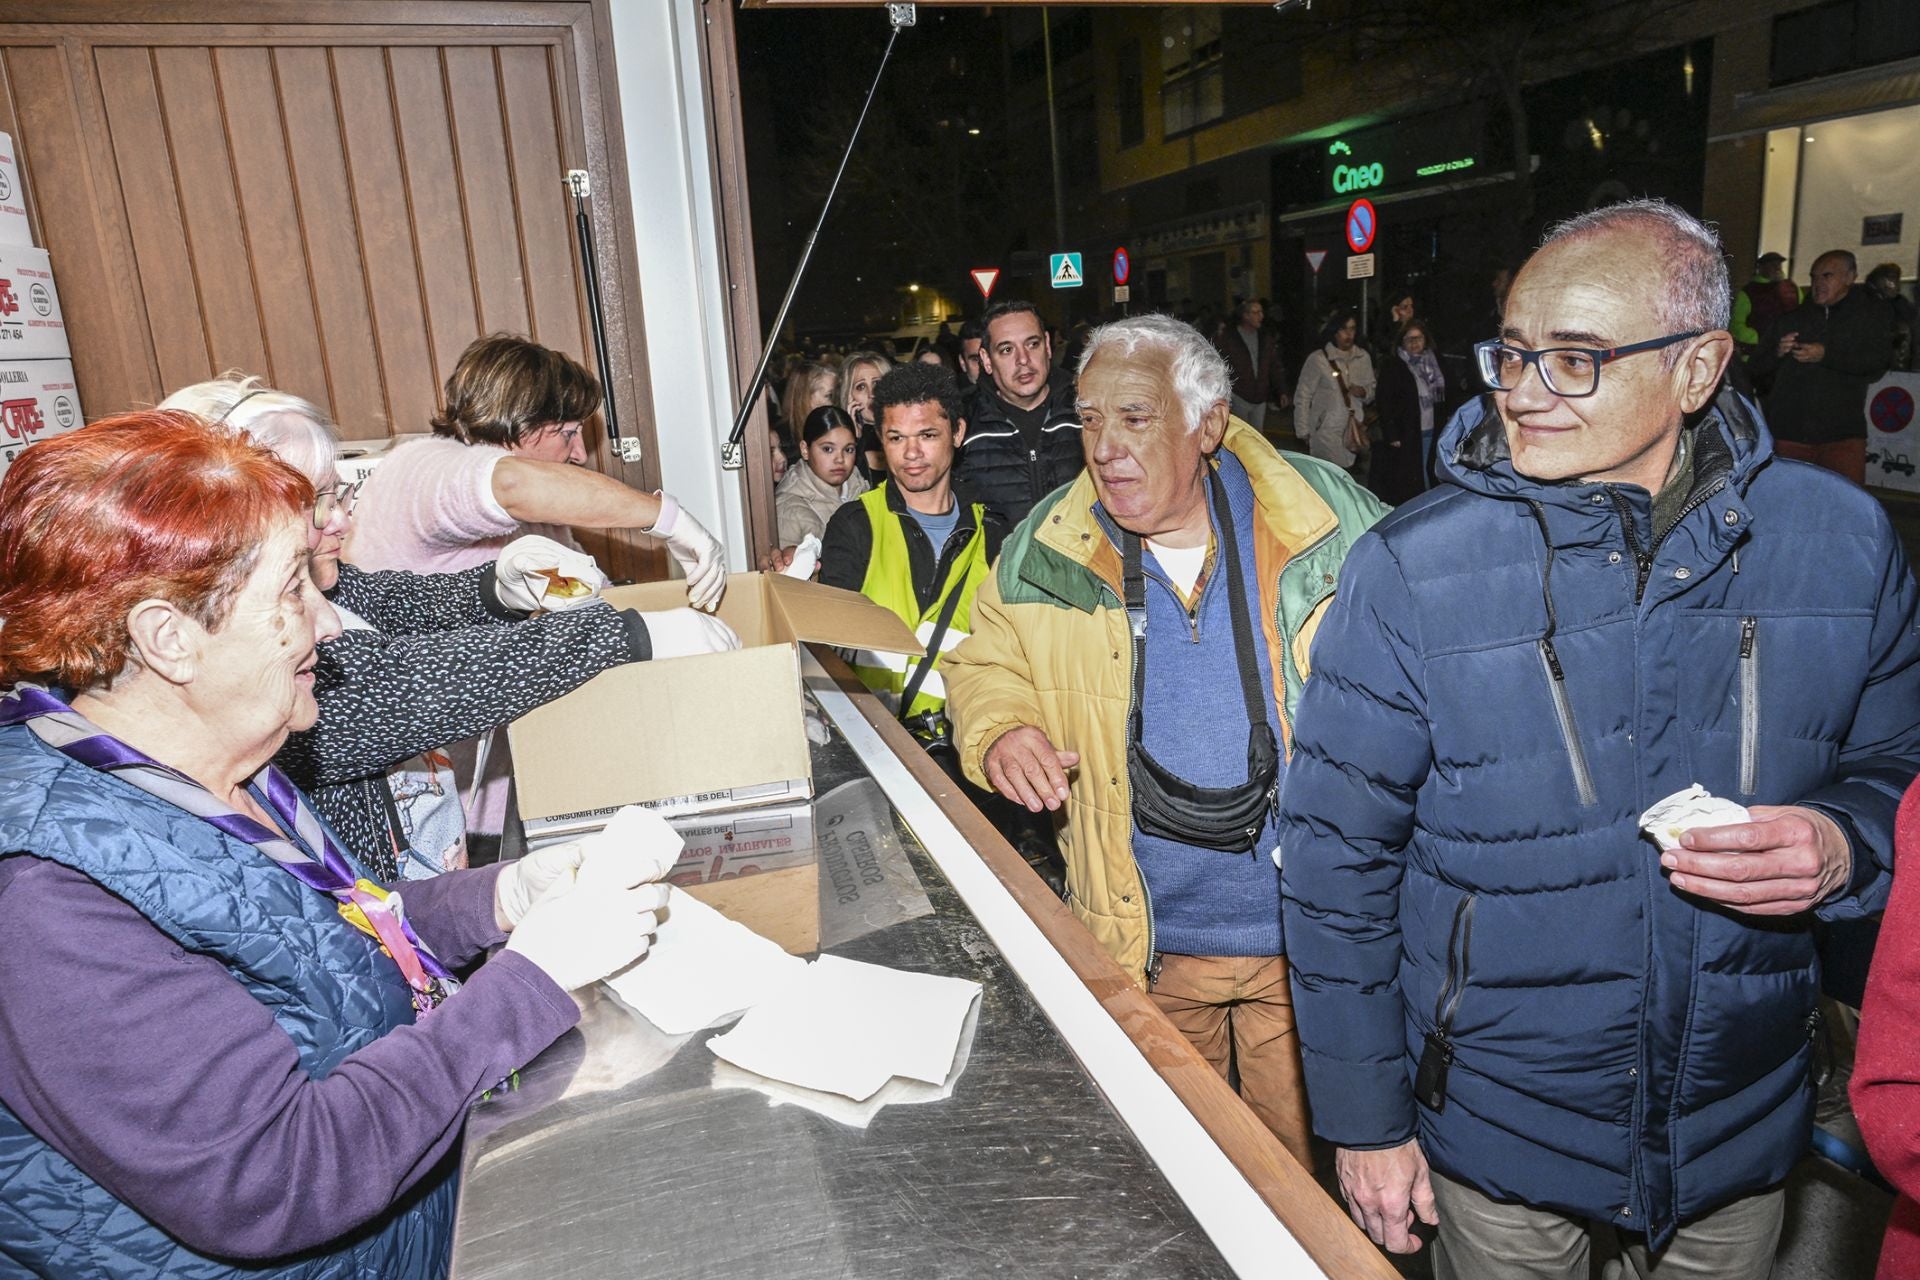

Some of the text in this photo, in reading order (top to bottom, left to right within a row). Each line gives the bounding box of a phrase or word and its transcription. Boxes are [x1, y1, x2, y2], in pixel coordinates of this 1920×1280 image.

[1333, 163, 1383, 193] Cneo
[0, 371, 29, 383] OLLERIA
[545, 810, 593, 822] CONSUMIR
